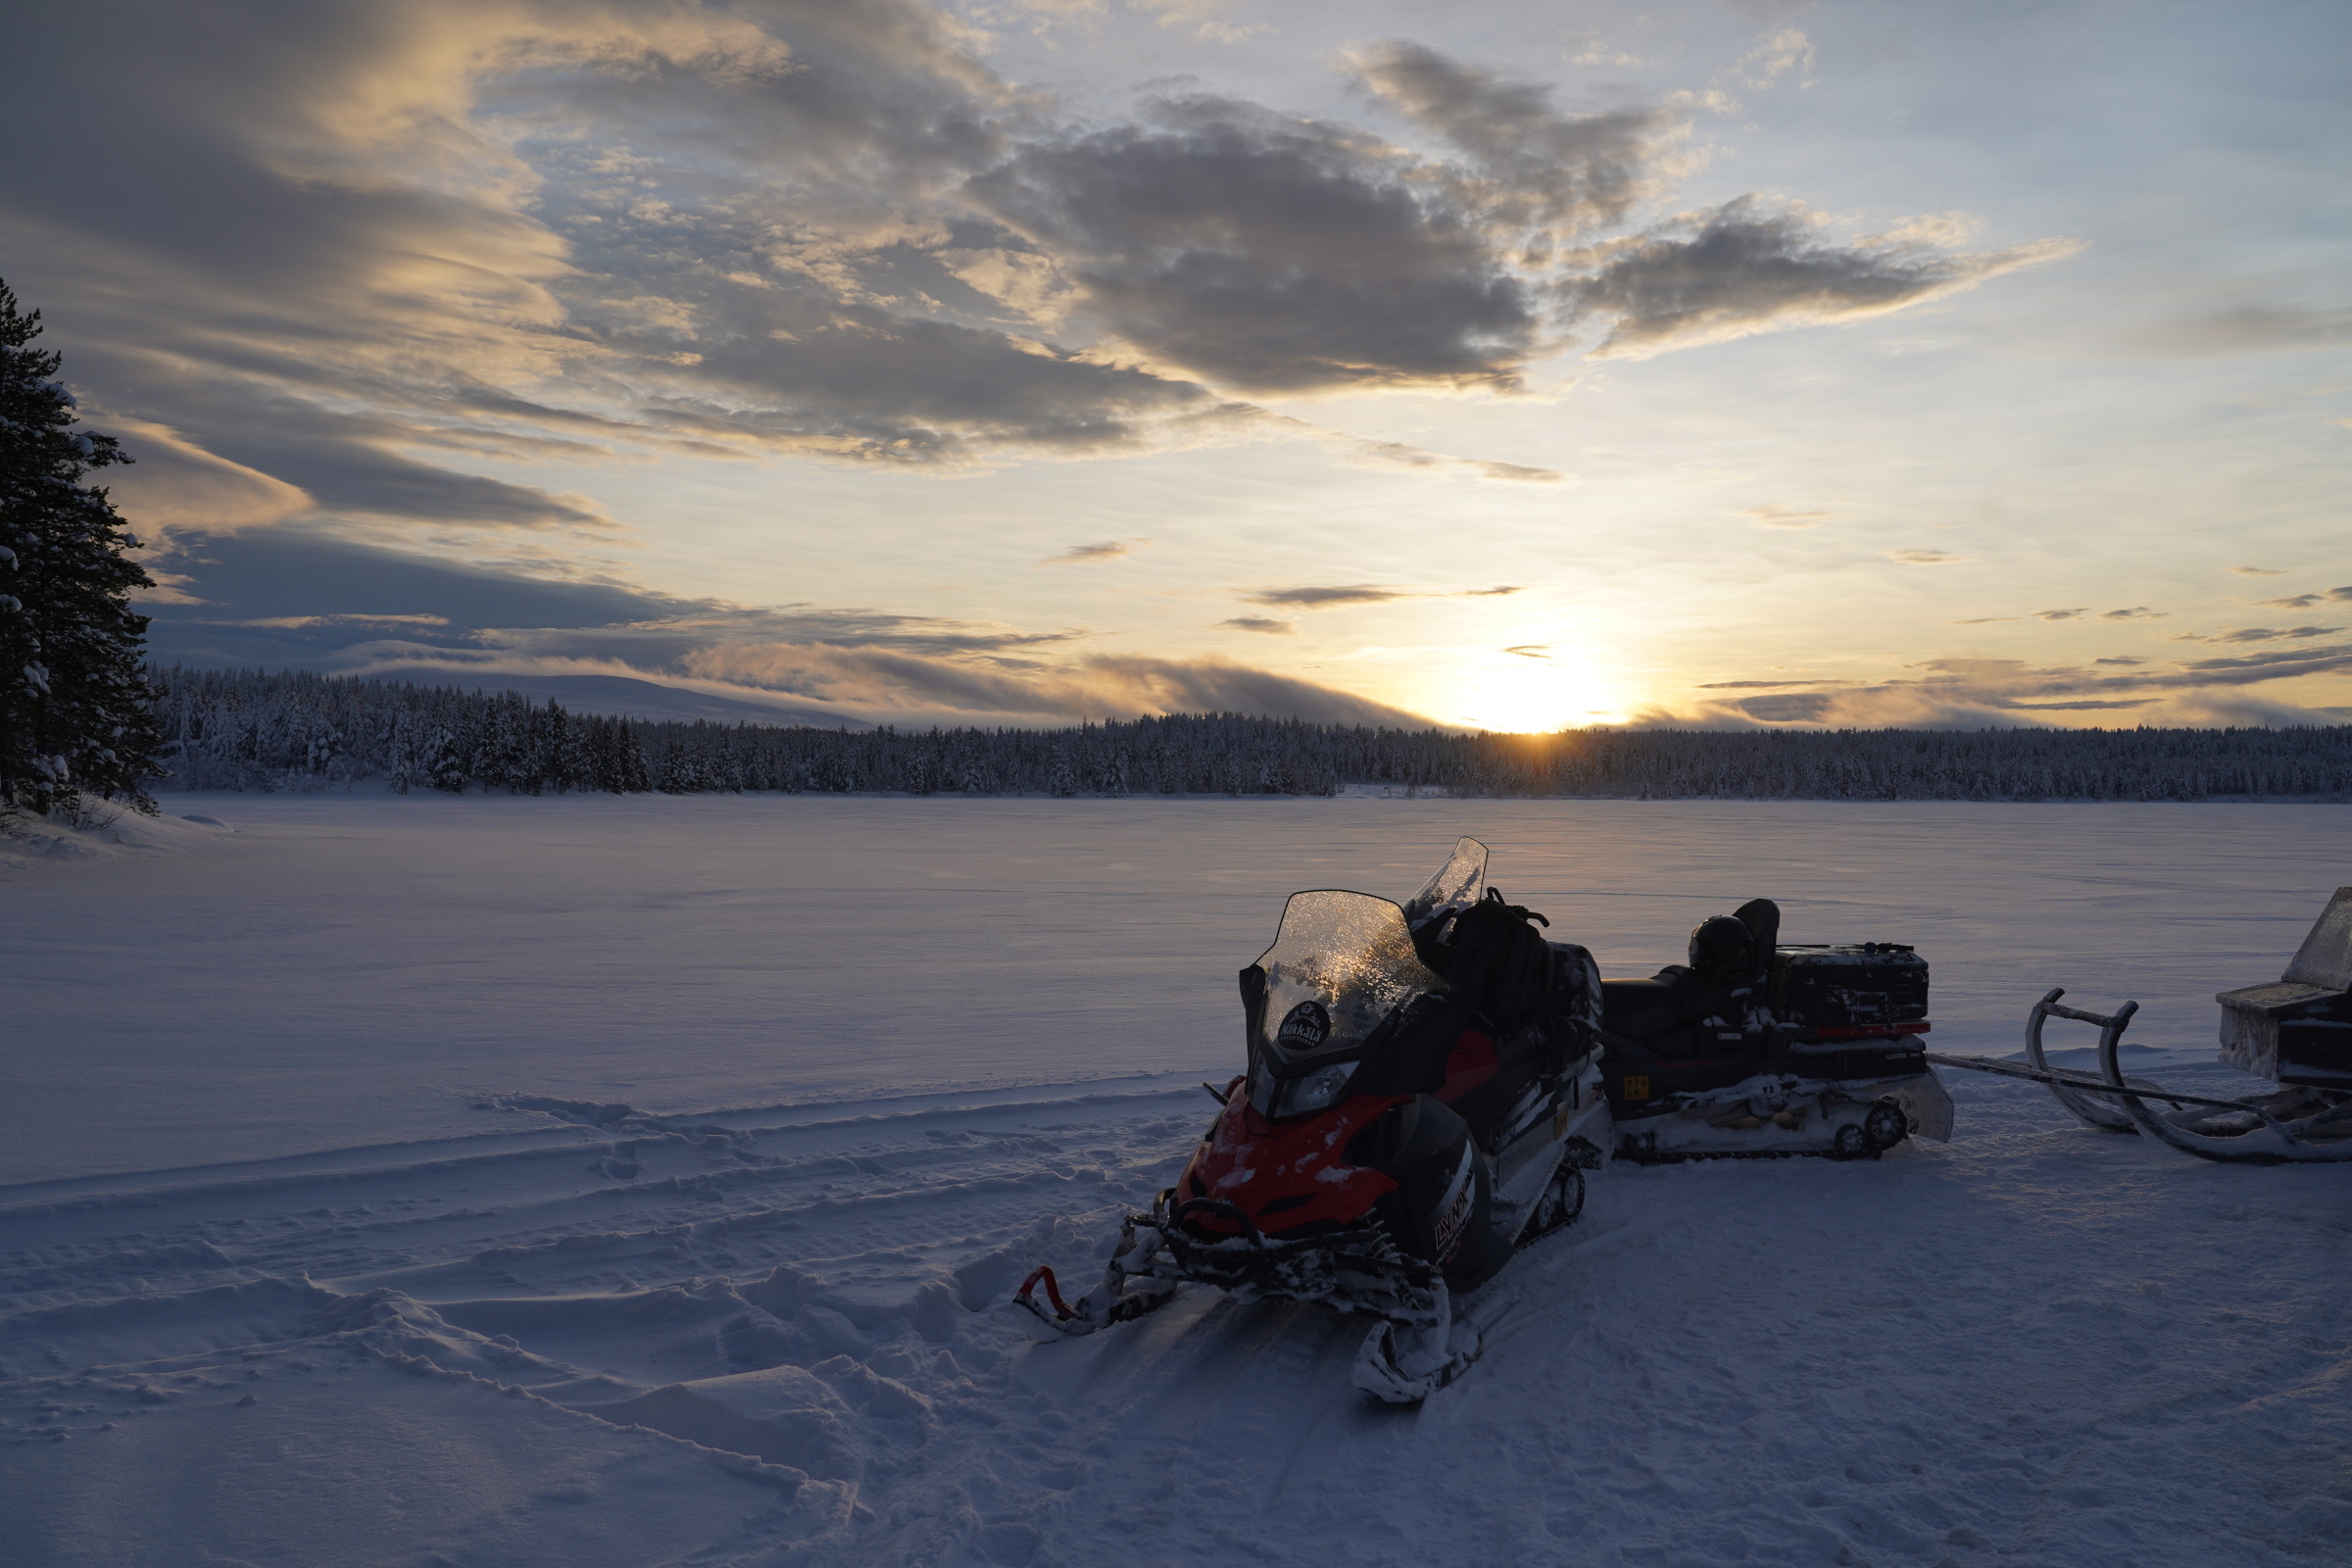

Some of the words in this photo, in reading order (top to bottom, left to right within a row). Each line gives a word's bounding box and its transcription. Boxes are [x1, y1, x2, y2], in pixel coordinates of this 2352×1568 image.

[1280, 1035, 1315, 1047] ADVENTURES
[1281, 1023, 1323, 1043] Näkkälä
[1627, 1077, 1646, 1088] 976
[1435, 1184, 1469, 1251] LYNX
